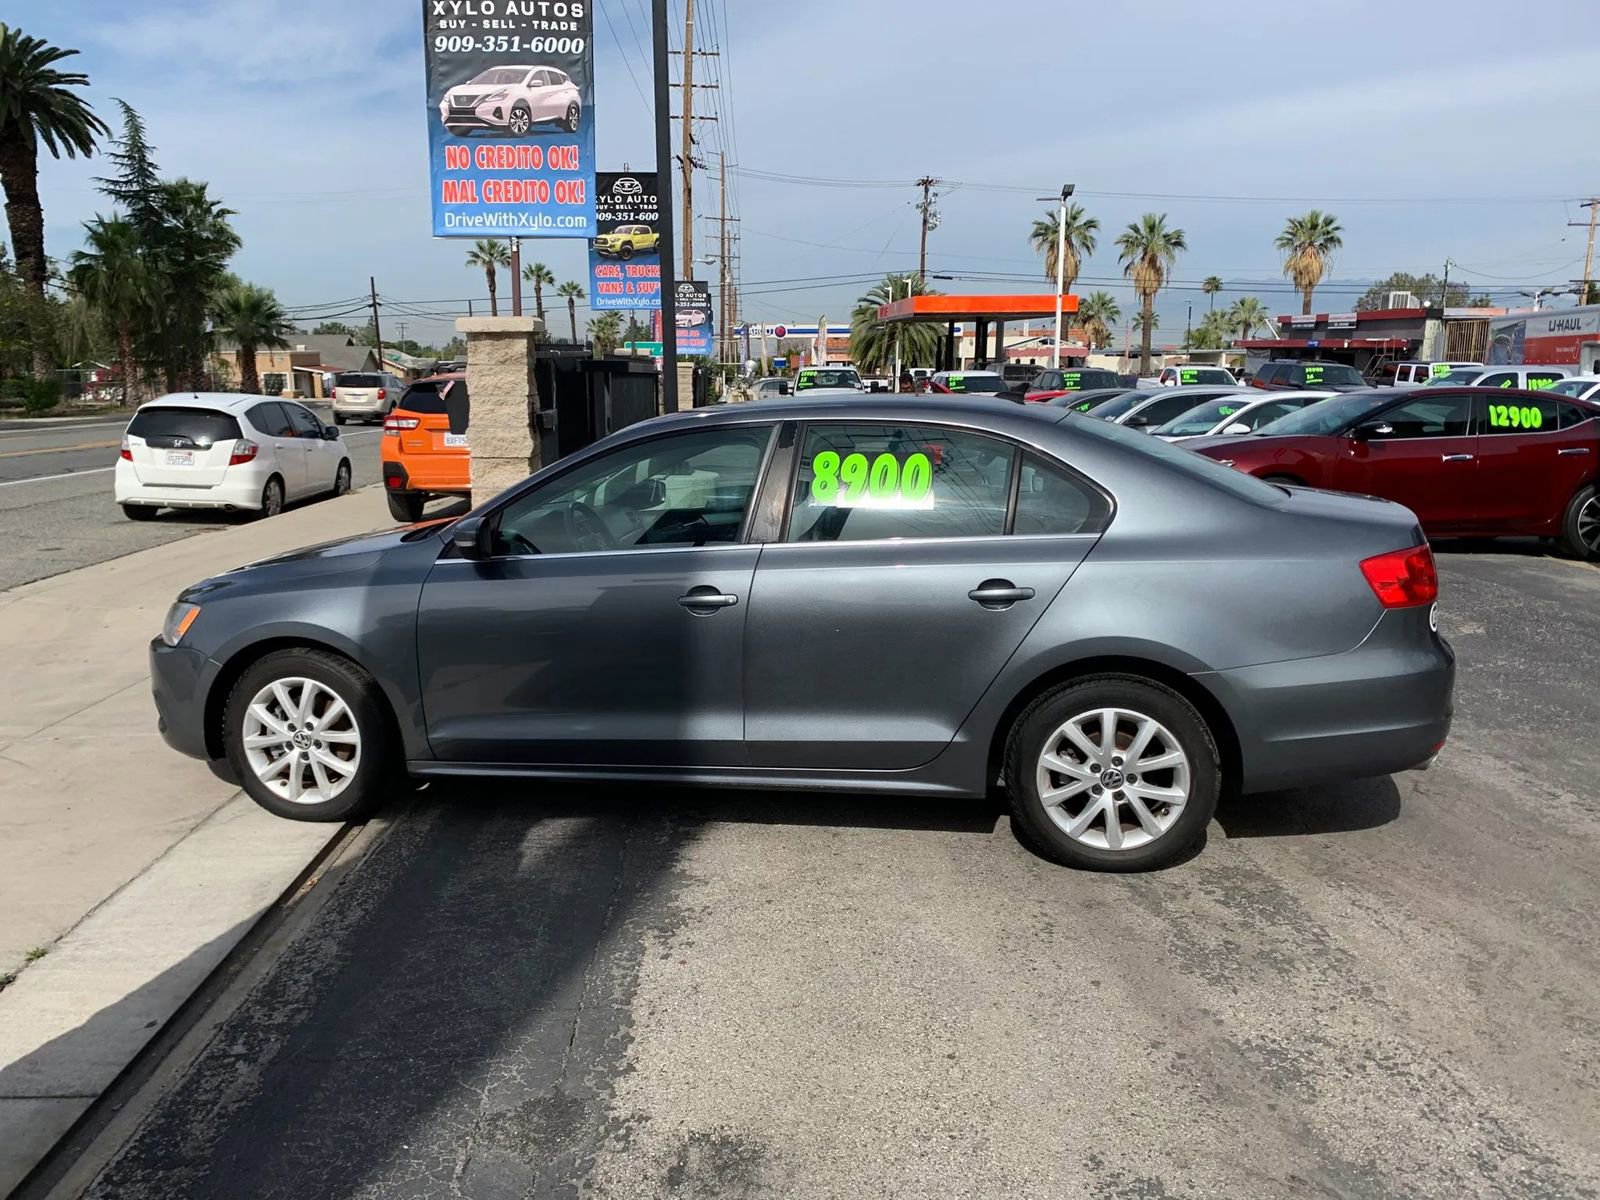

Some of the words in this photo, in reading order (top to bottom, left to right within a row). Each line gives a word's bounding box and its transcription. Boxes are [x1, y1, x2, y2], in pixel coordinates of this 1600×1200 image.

[432, 0, 495, 15] XYLO
[505, 0, 584, 18] AUTOS
[439, 19, 467, 29] BUY
[482, 19, 516, 29] SELL
[532, 20, 577, 31] TRADE
[434, 35, 585, 54] 909-351-6000
[445, 145, 470, 170] NO
[475, 145, 544, 171] CREDITO
[548, 145, 580, 171] OK!
[442, 179, 478, 204] MAL
[482, 179, 550, 205] CREDITO
[554, 179, 586, 205] OK!
[595, 195, 622, 203] YLO
[626, 195, 658, 203] AUTO
[444, 212, 587, 230] DriveWithXylo.com
[595, 212, 659, 221] 09-351-600
[595, 264, 624, 280] CARS,
[597, 281, 624, 294] VANS
[625, 281, 635, 294] &
[596, 297, 661, 307] DriveWithXylo.co
[748, 327, 772, 337] ARO
[1548, 318, 1582, 332] U-HAUL
[1488, 404, 1543, 429] 12900
[811, 450, 934, 502] 8900
